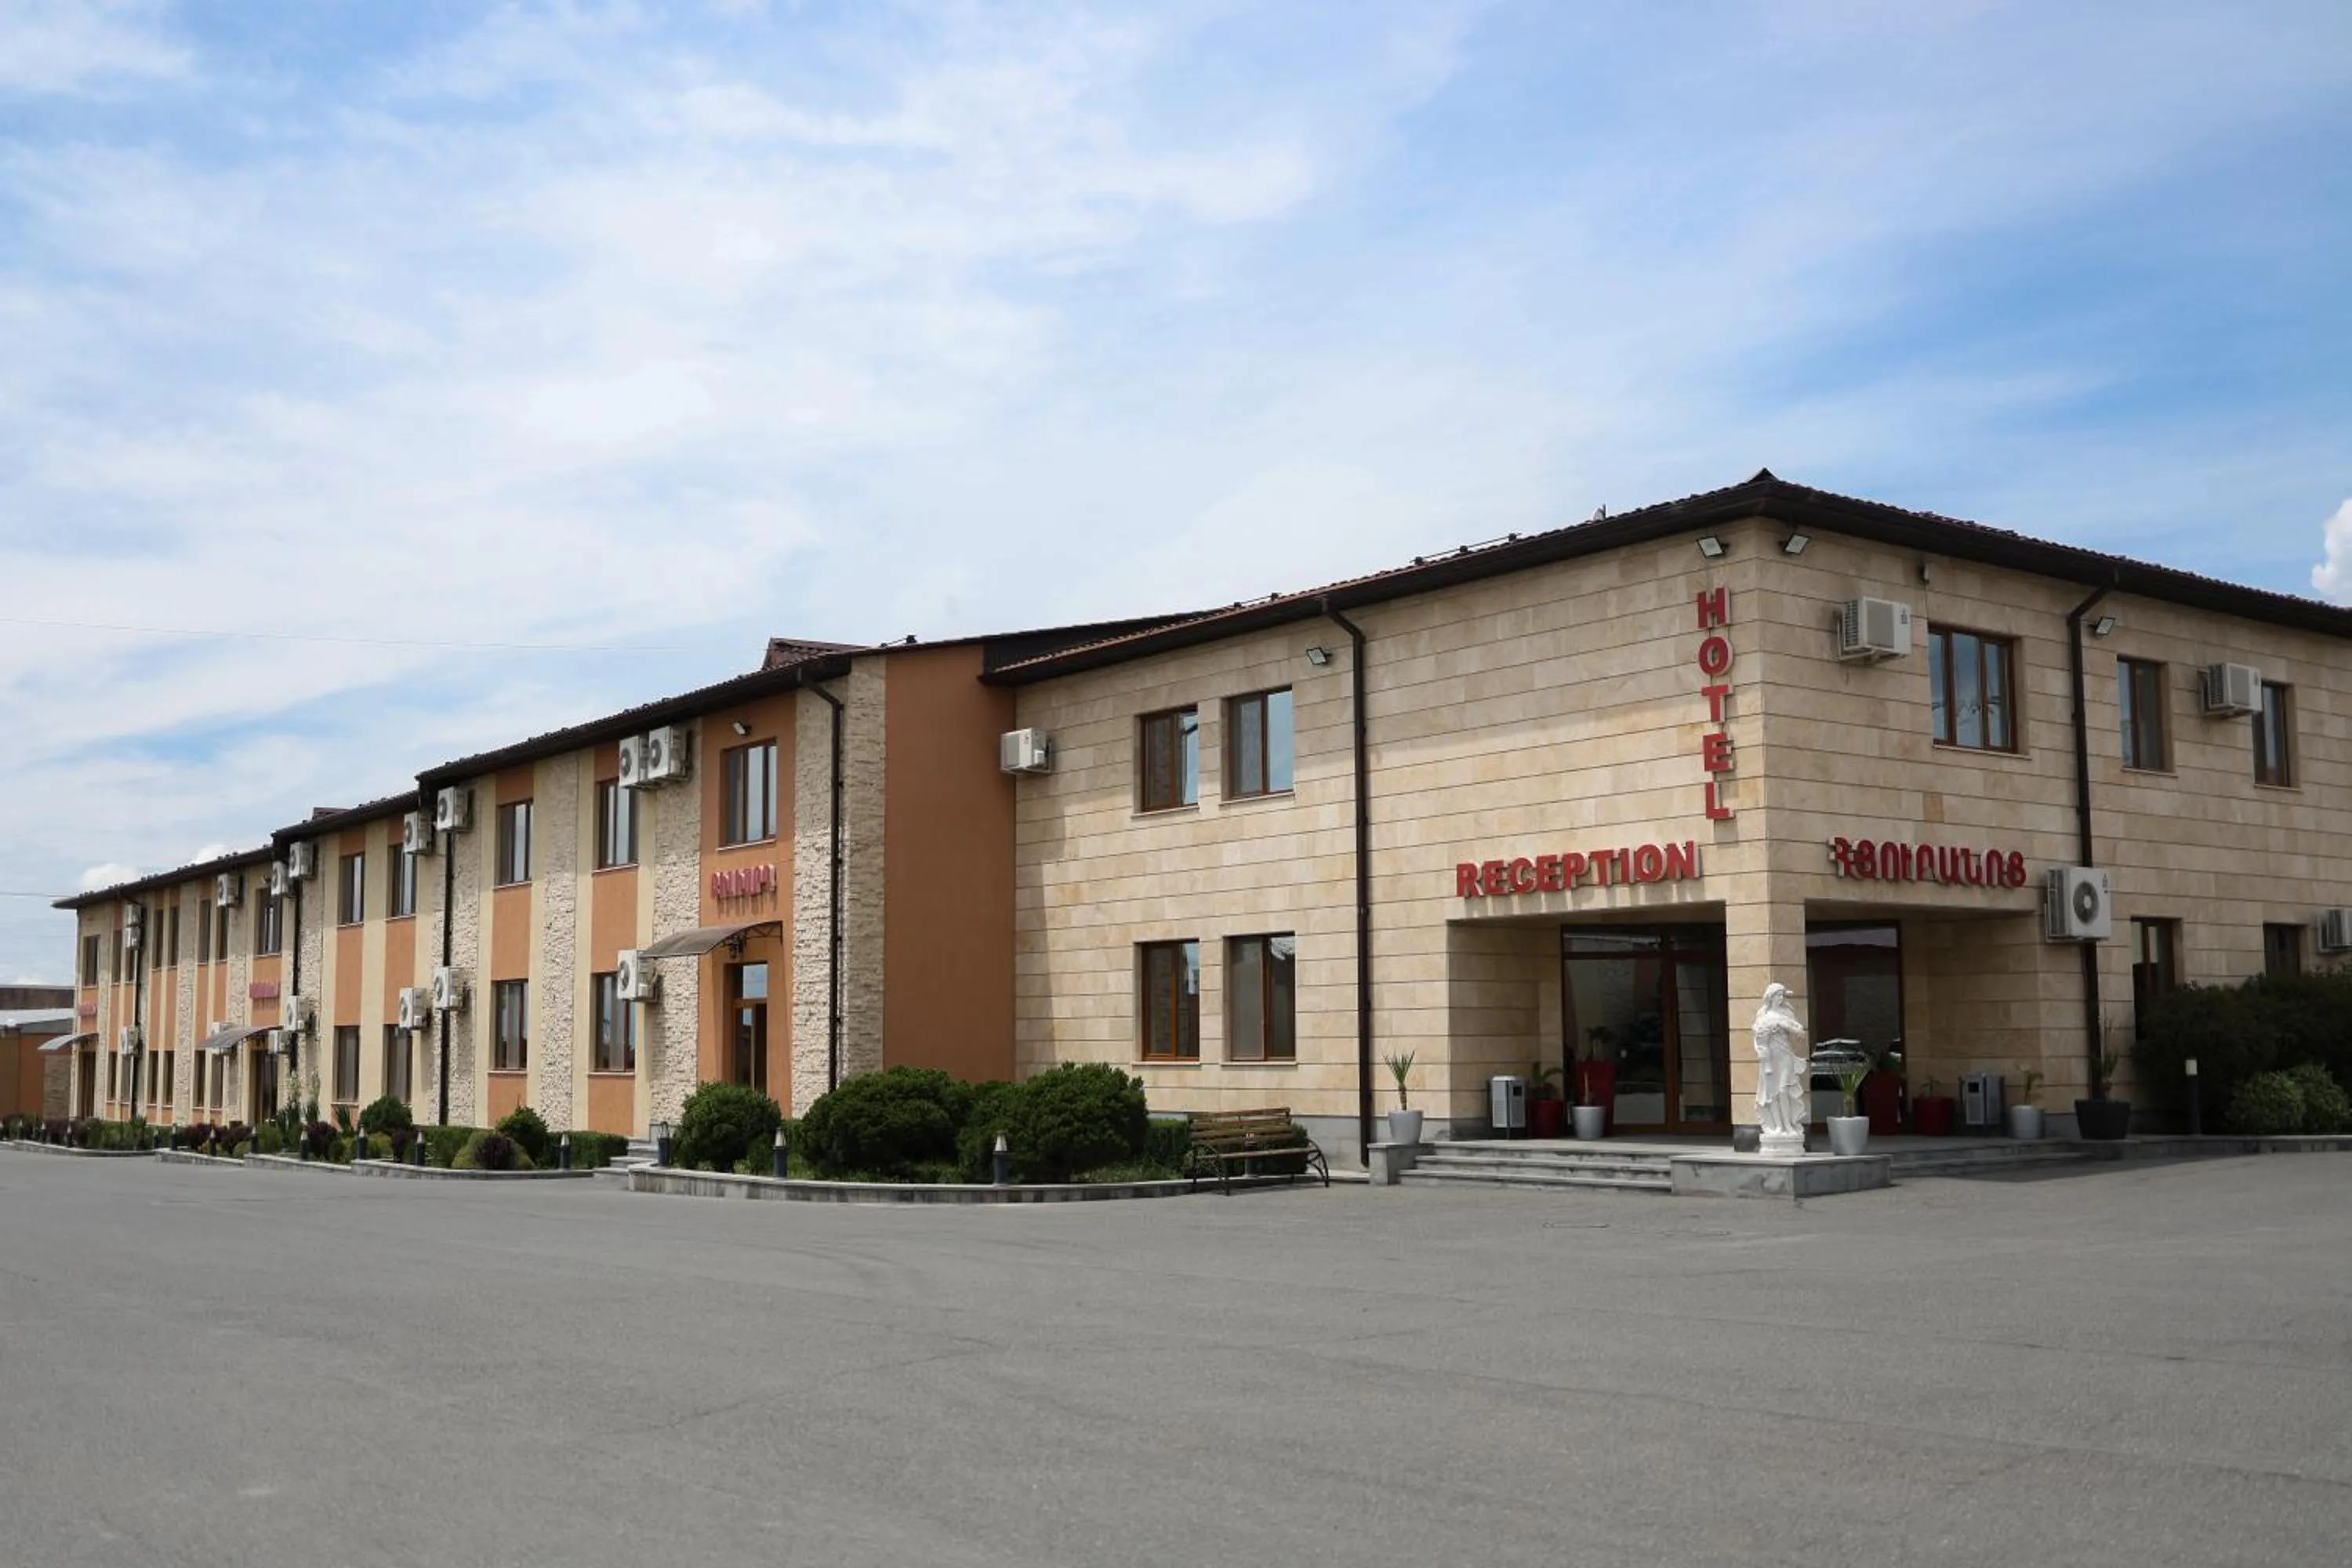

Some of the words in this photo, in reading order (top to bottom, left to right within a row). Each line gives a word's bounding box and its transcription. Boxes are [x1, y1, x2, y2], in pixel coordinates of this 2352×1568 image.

[1697, 587, 1733, 820] HOTEL
[1456, 840, 1698, 898] RECEPTION
[1831, 837, 2027, 888] ՀՅՈՒՐԱՆՈՑ
